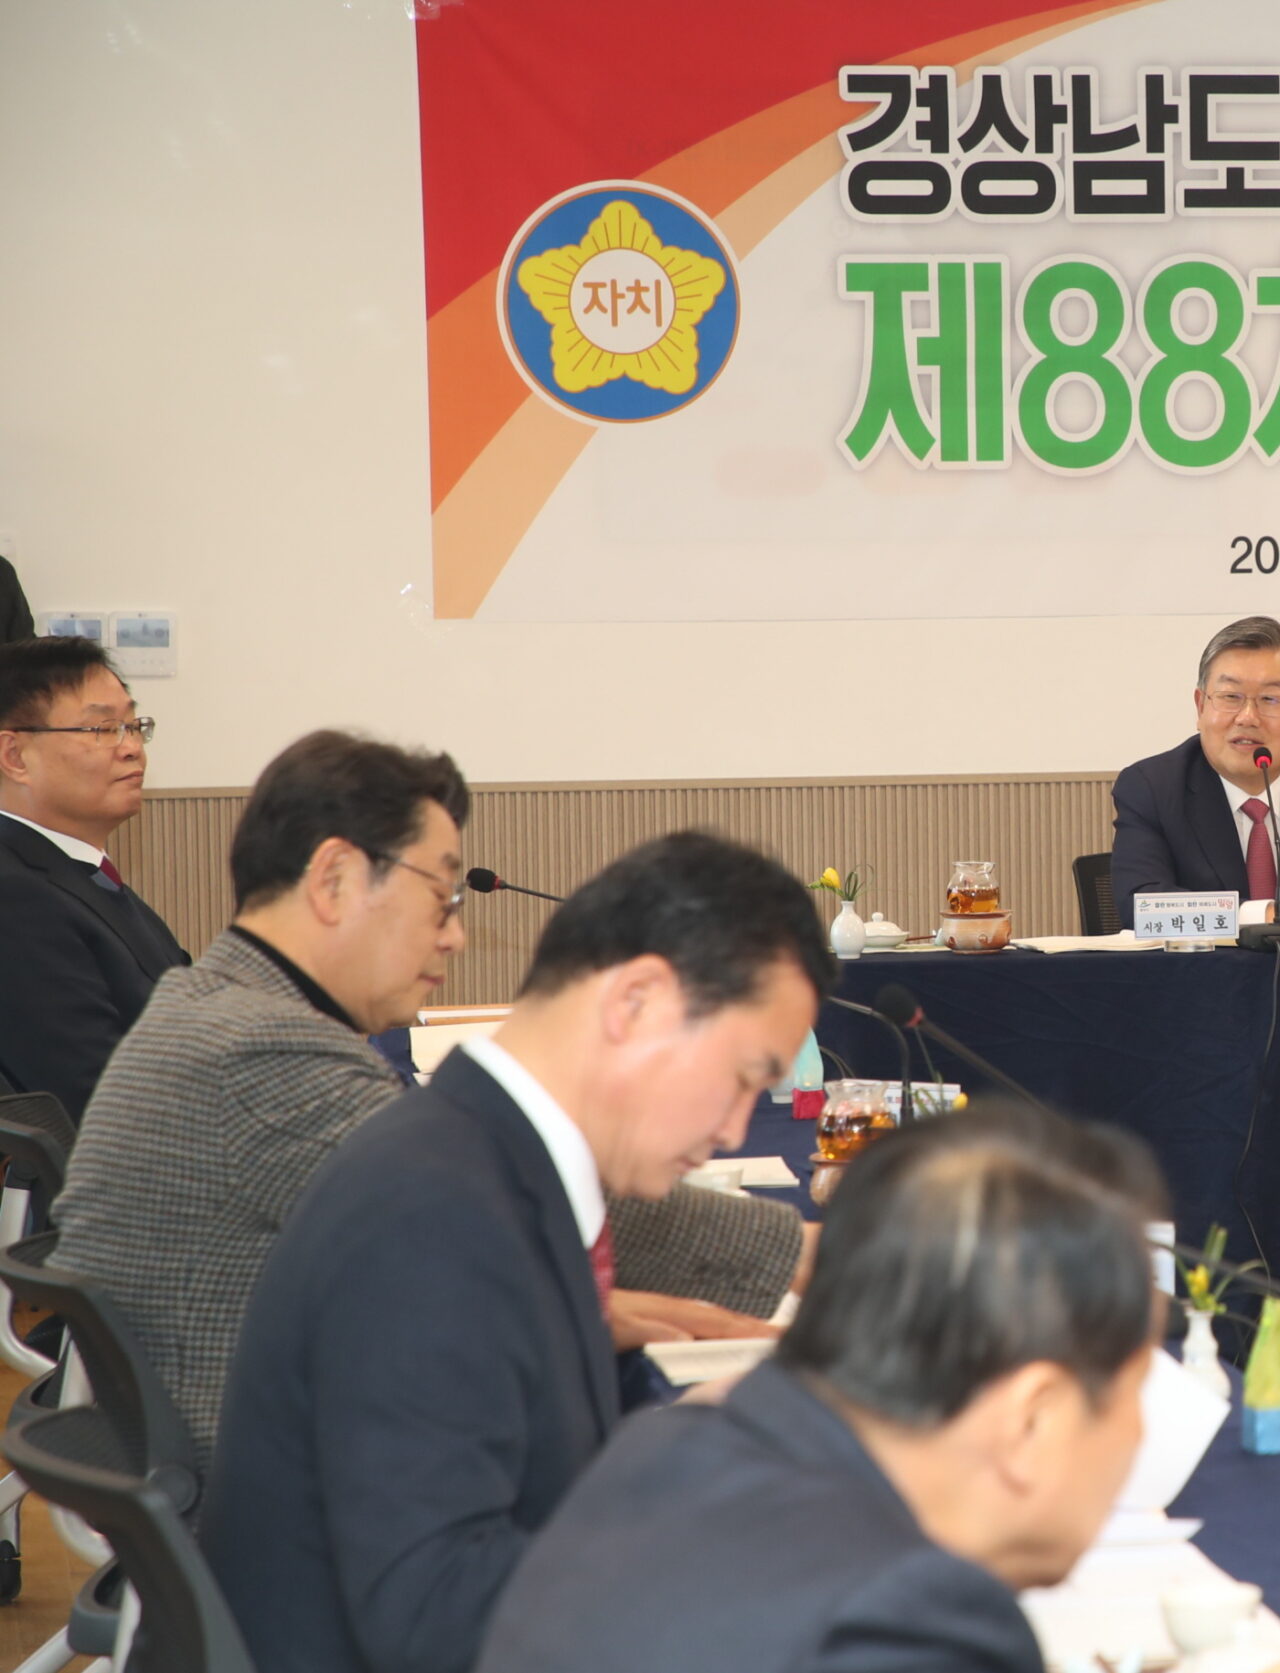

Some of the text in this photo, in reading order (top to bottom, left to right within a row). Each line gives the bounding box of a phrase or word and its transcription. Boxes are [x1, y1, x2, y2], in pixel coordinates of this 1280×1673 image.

[582, 278, 663, 328] 자치
[1143, 914, 1229, 933] 시장 박일호
